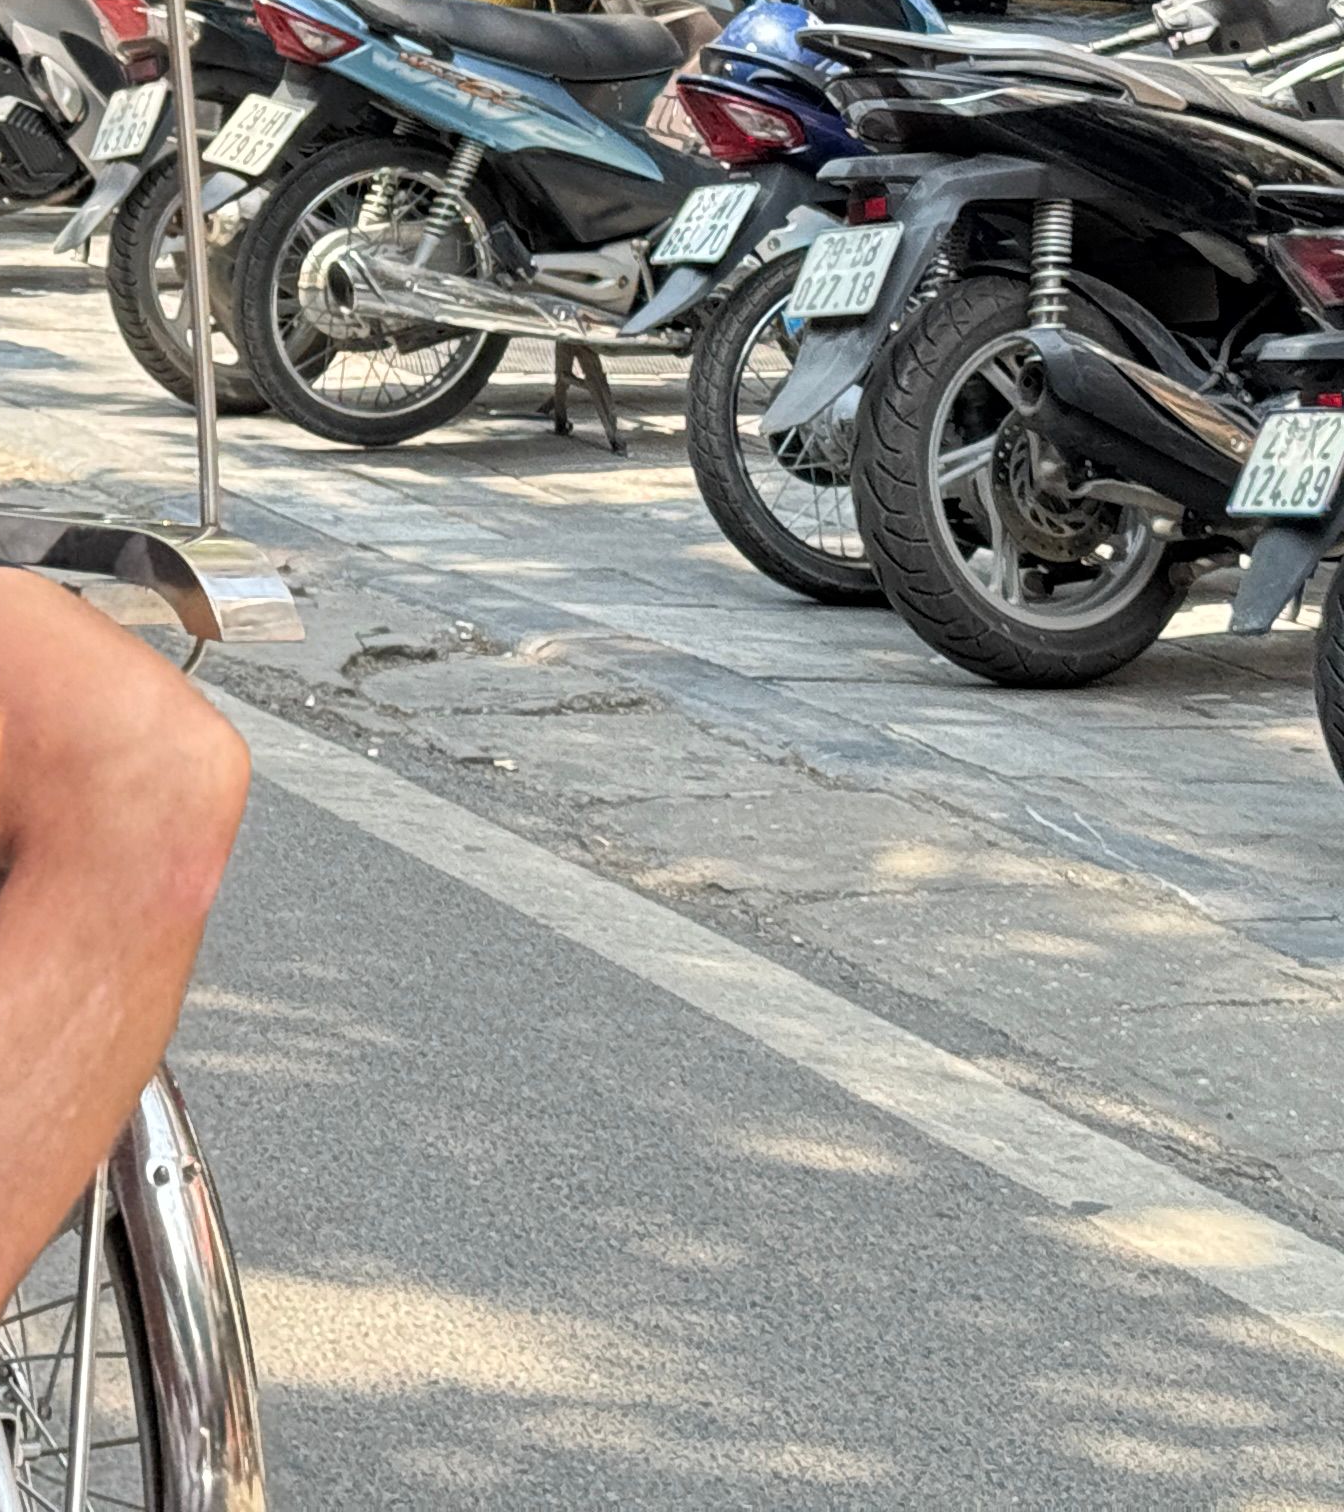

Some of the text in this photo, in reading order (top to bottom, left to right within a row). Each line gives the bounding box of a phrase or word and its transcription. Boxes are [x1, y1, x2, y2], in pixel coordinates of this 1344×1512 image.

[236, 102, 293, 138] 29-H1
[212, 130, 275, 167] 179.67
[793, 271, 876, 311] 027.18
[1240, 464, 1331, 508] 124.89
